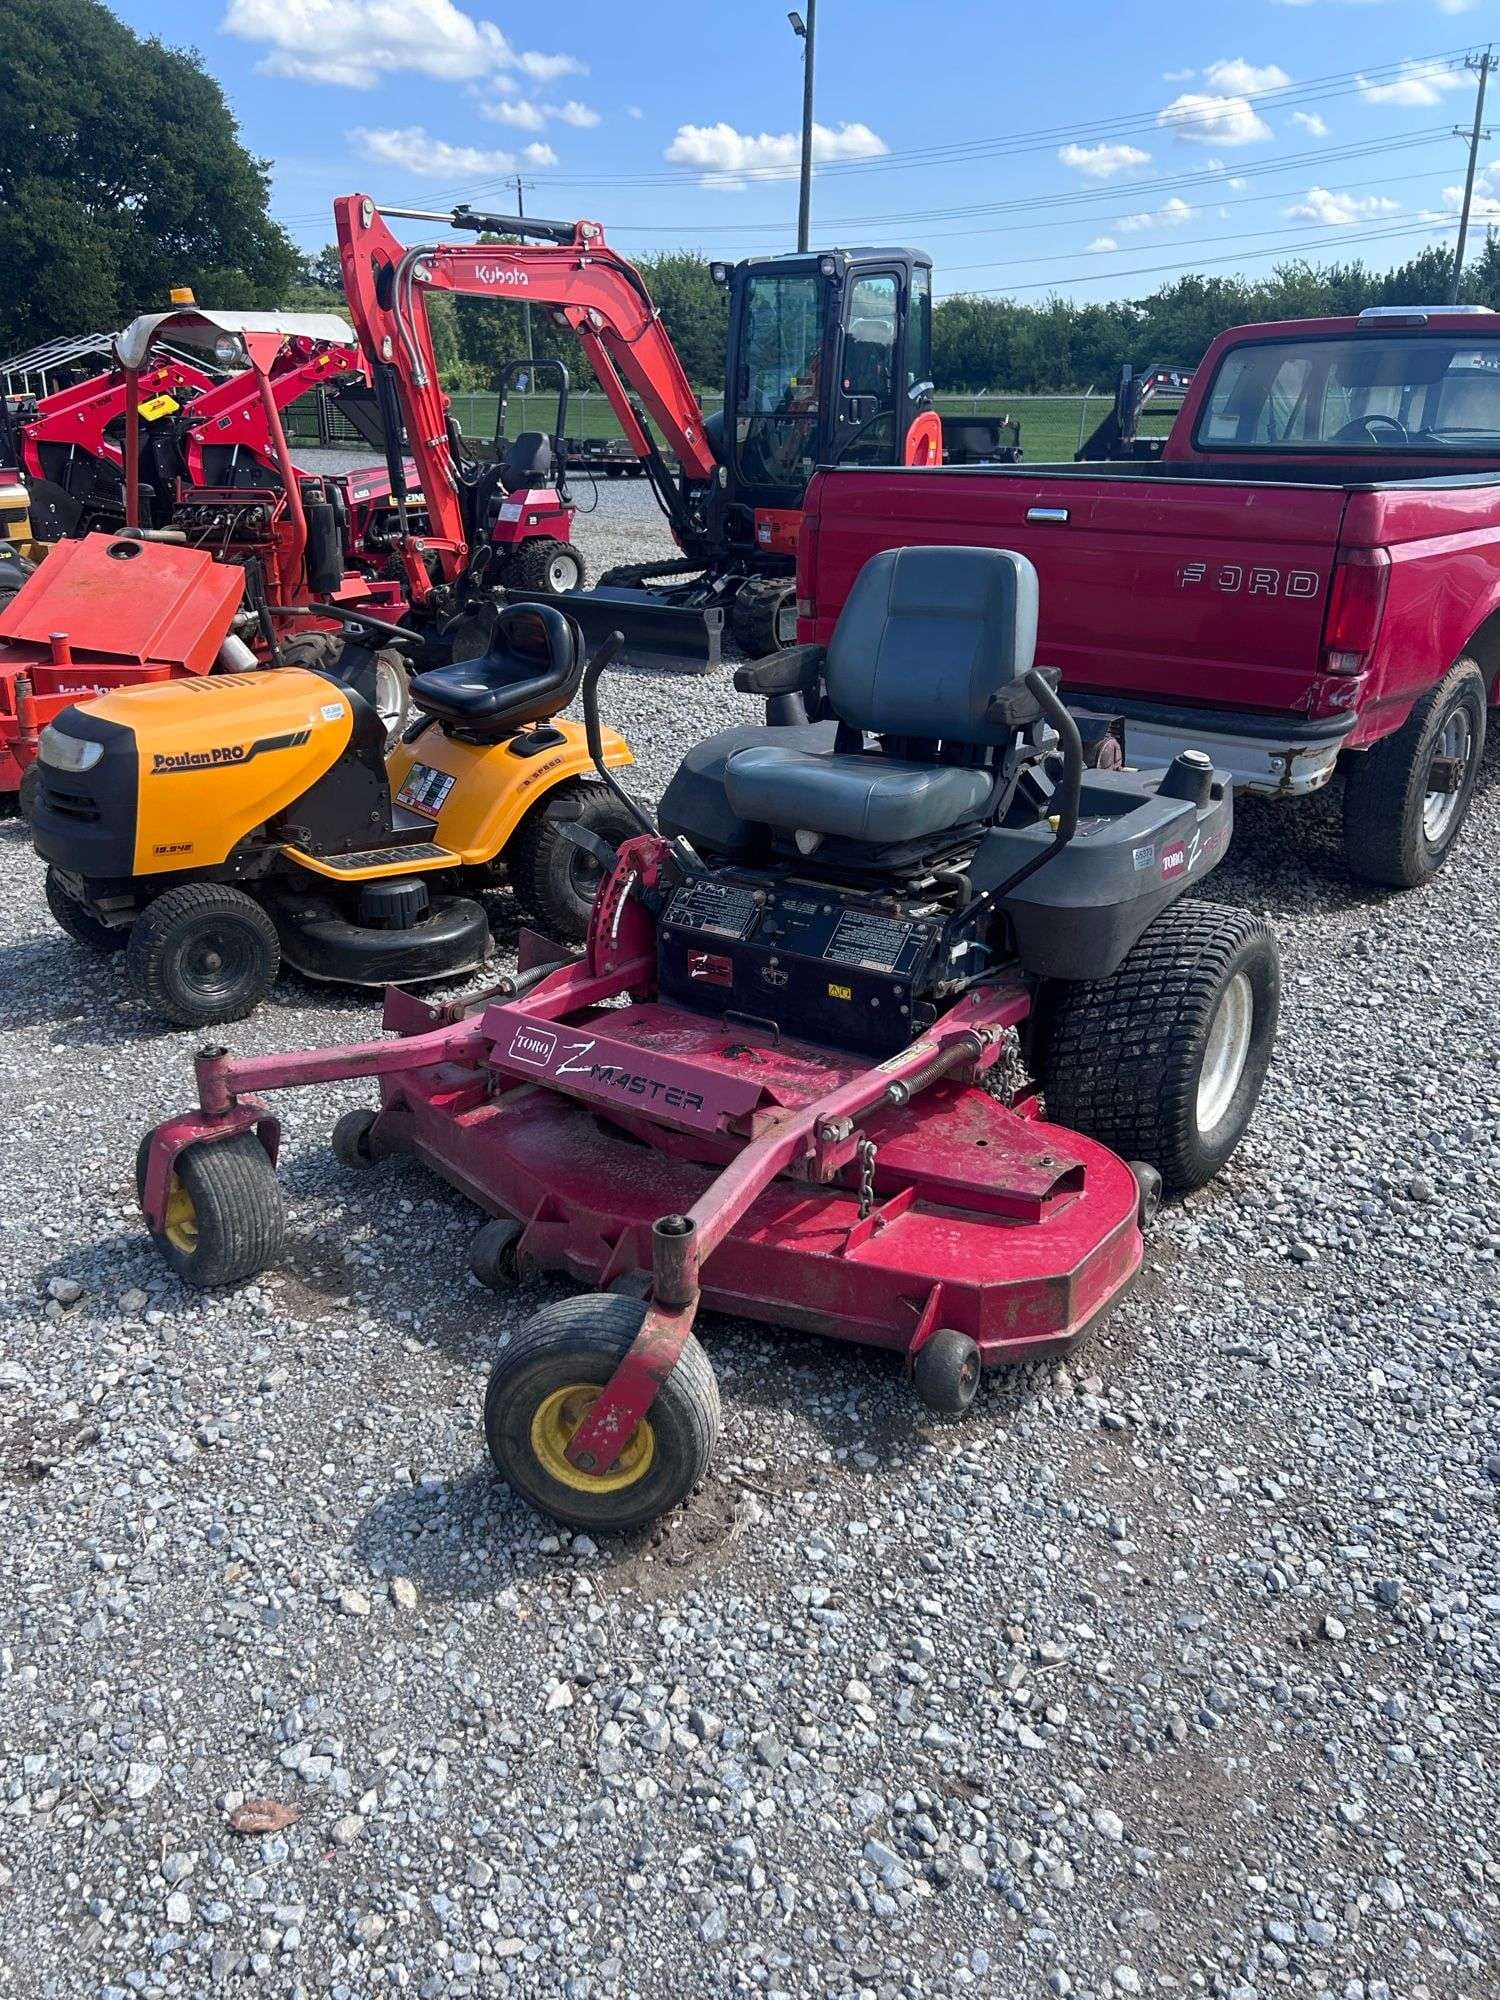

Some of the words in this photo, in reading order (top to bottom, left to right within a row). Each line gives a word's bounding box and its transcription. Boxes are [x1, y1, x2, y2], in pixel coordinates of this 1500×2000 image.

[475, 265, 529, 285] Kubota
[1176, 563, 1320, 598] FORD
[1162, 851, 1185, 871] TORO
[517, 1035, 549, 1056] TORO
[590, 1064, 705, 1112] MASTER
